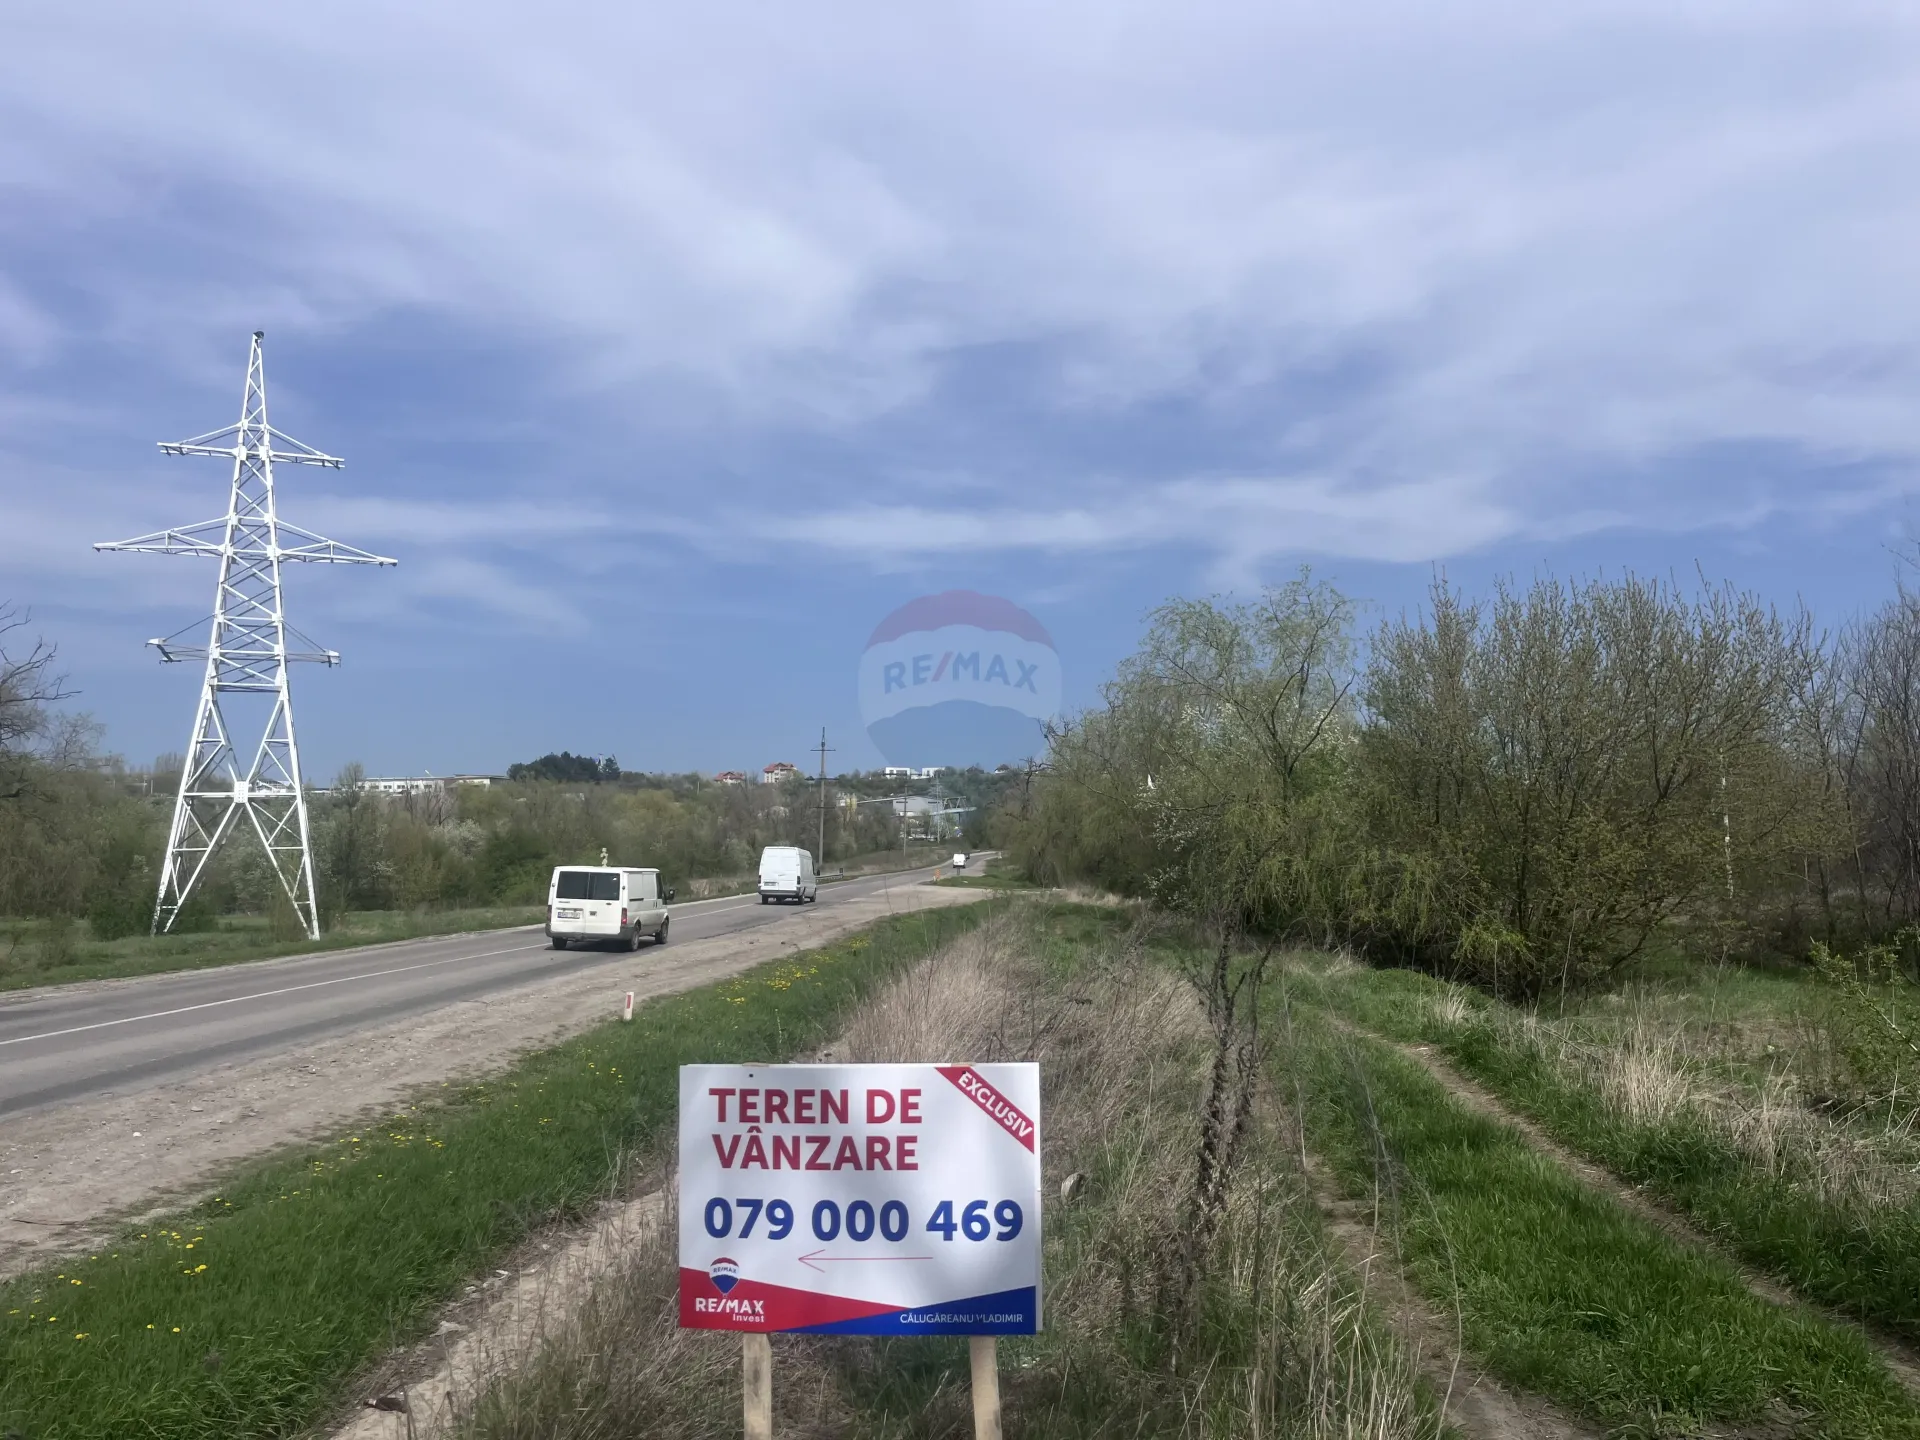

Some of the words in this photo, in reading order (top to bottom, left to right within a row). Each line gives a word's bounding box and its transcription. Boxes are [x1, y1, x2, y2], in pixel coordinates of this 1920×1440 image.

[708, 1088, 849, 1124] TEREN
[866, 1088, 922, 1124] DE
[958, 1071, 1033, 1137] EXCLUSIV
[711, 1126, 919, 1171] VÂNZARE
[704, 1197, 794, 1240] 079
[812, 1199, 909, 1242] 000
[925, 1199, 1023, 1242] 469
[713, 1266, 737, 1274] RE/MAX
[695, 1297, 764, 1315] RE/MAX
[900, 1312, 973, 1323] CĂLUGĂREANU
